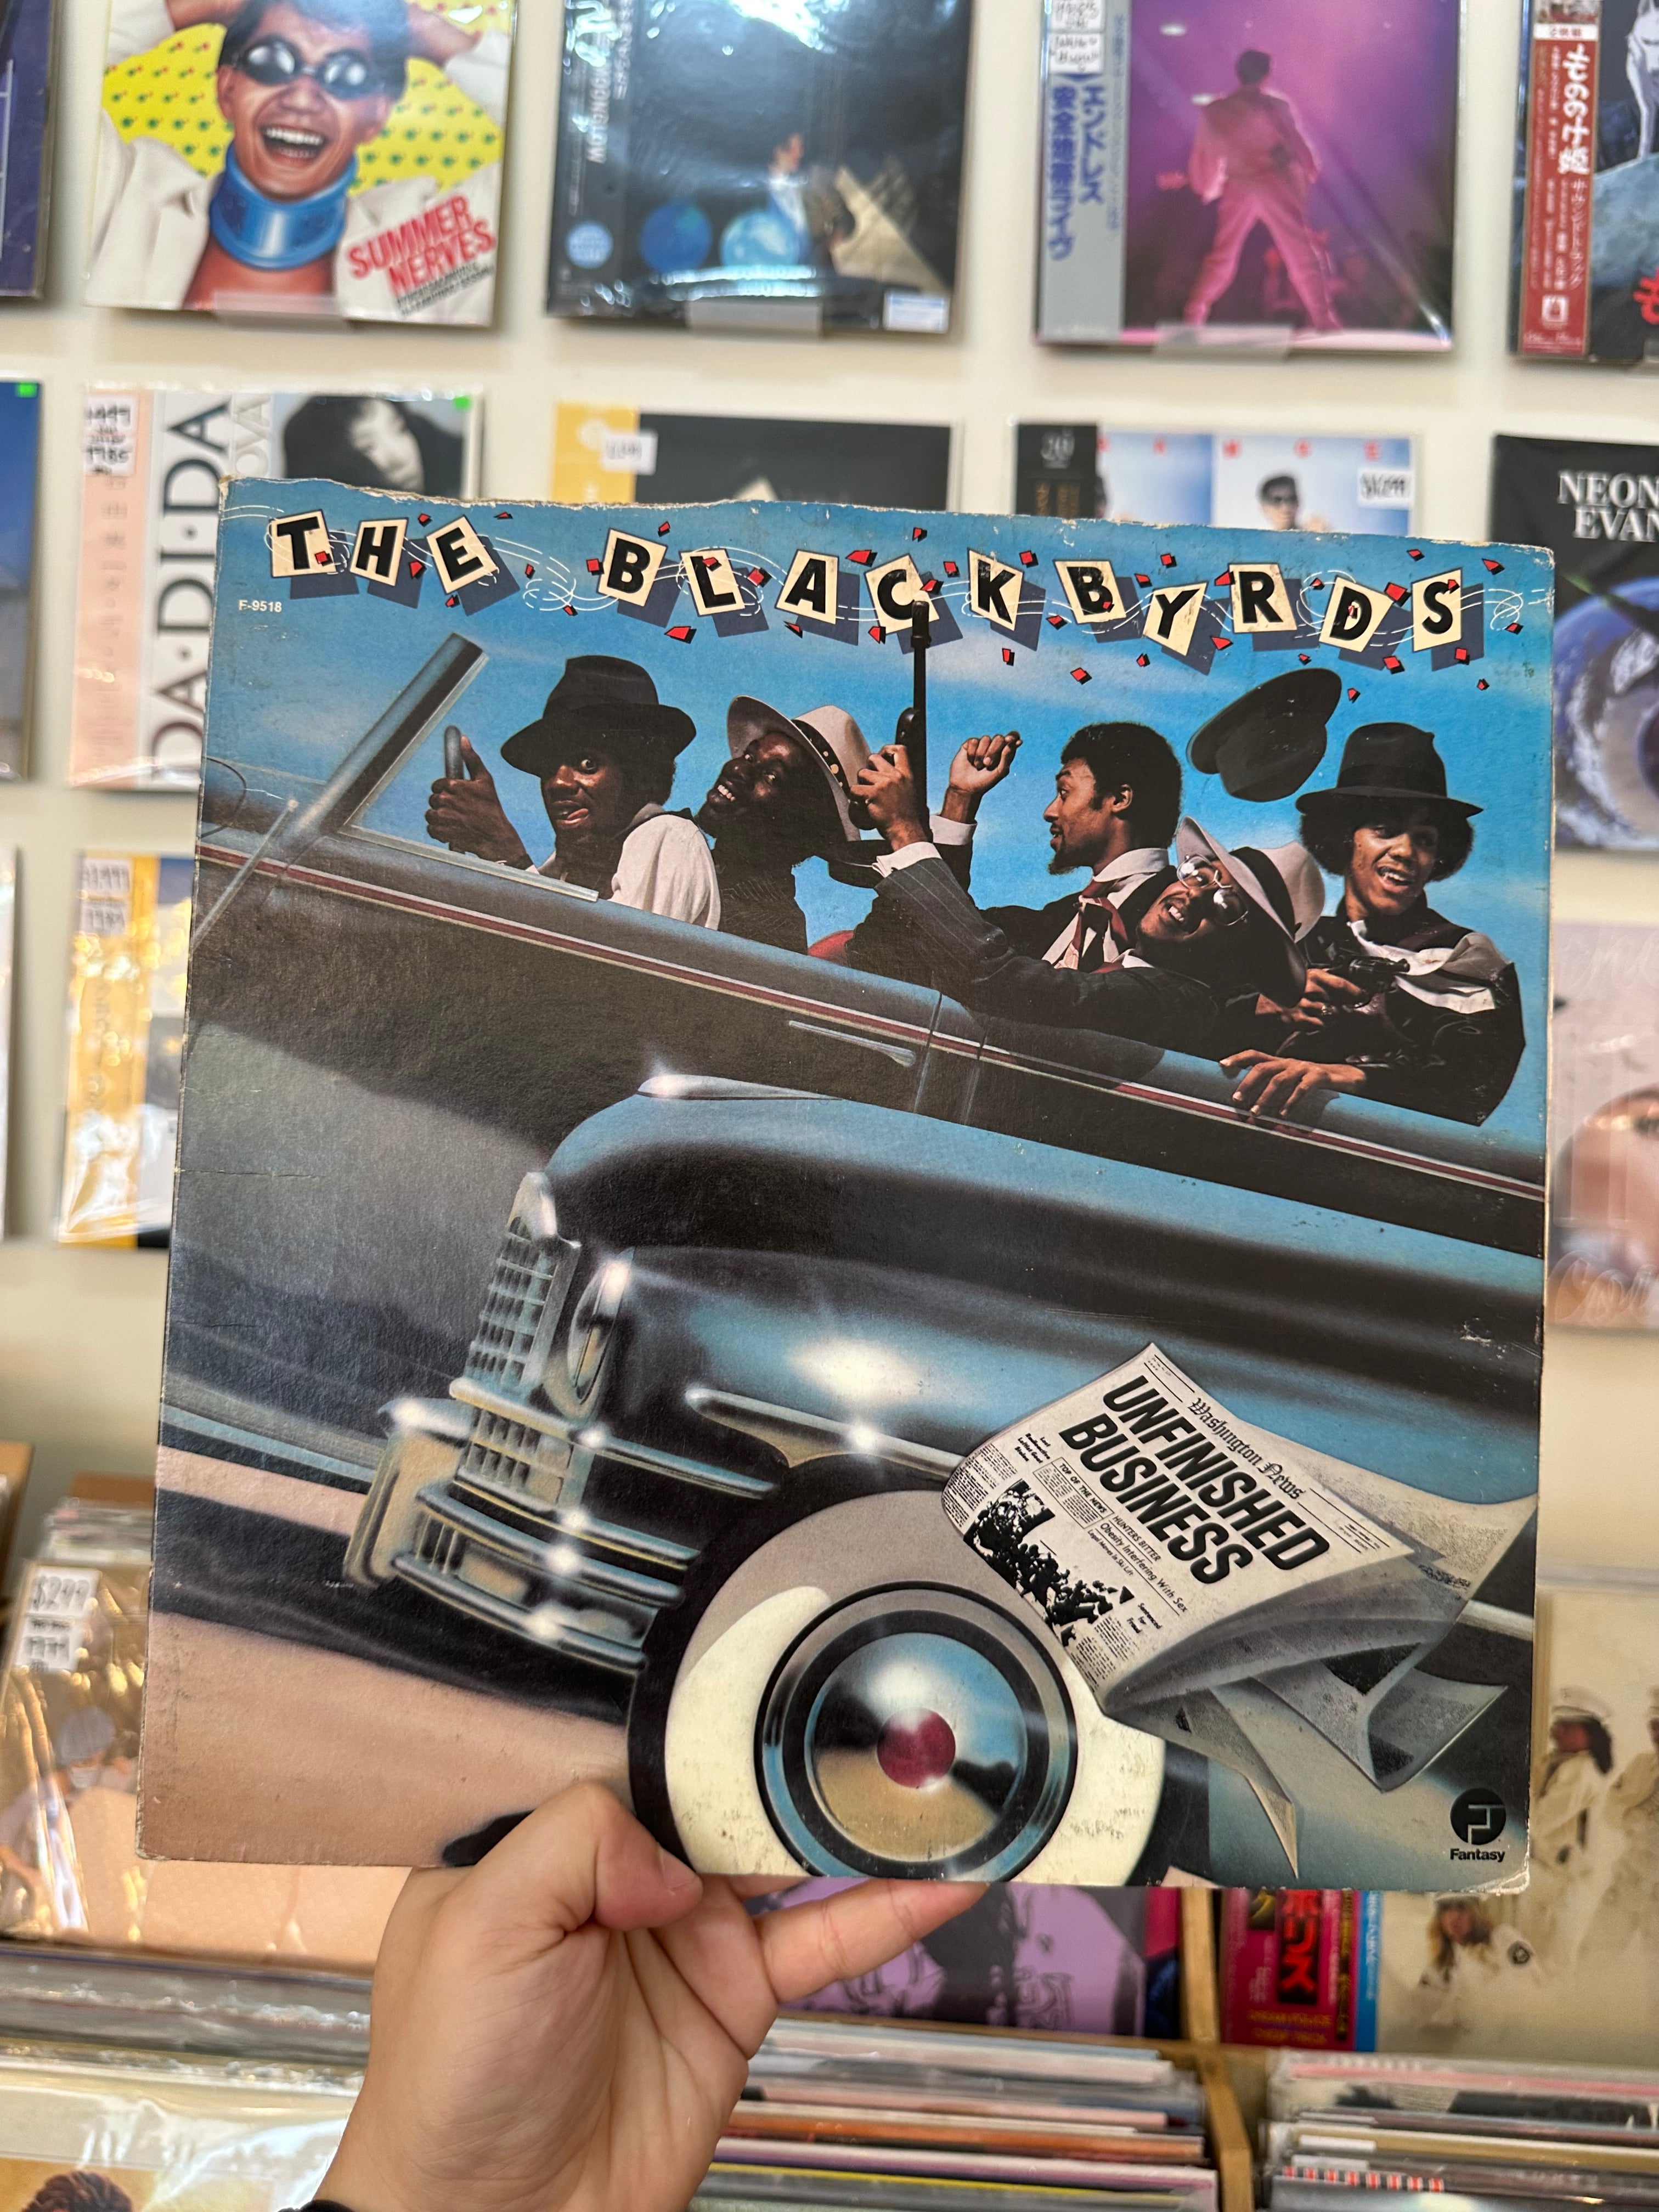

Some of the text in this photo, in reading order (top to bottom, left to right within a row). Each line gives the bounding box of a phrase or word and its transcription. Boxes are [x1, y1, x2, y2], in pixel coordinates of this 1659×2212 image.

[1079, 85, 1105, 206] エンドレス
[1557, 42, 1590, 176] もののけ姫
[348, 194, 473, 279] SUMMER
[389, 217, 496, 298] NERVES
[1558, 471, 1659, 509] NEON
[239, 599, 283, 613] F-9518
[276, 516, 1456, 641] THE BLACKBYRDS
[1059, 1463, 1108, 1514] TOP OF THE NEWS
[1103, 1375, 1330, 1571] UNFINISHED
[1187, 1397, 1306, 1499] Washington News
[1058, 1413, 1253, 1584] BUSINESS
[1087, 1529, 1102, 1543] Legal
[1112, 1515, 1161, 1562] HUNTERS BITTER
[1100, 1522, 1188, 1612] Obesity Interfering With Sex
[1126, 1617, 1143, 1634] Fraud
[1137, 1602, 1163, 1629] Sentenced
[1450, 1848, 1505, 1863] Fantasy
